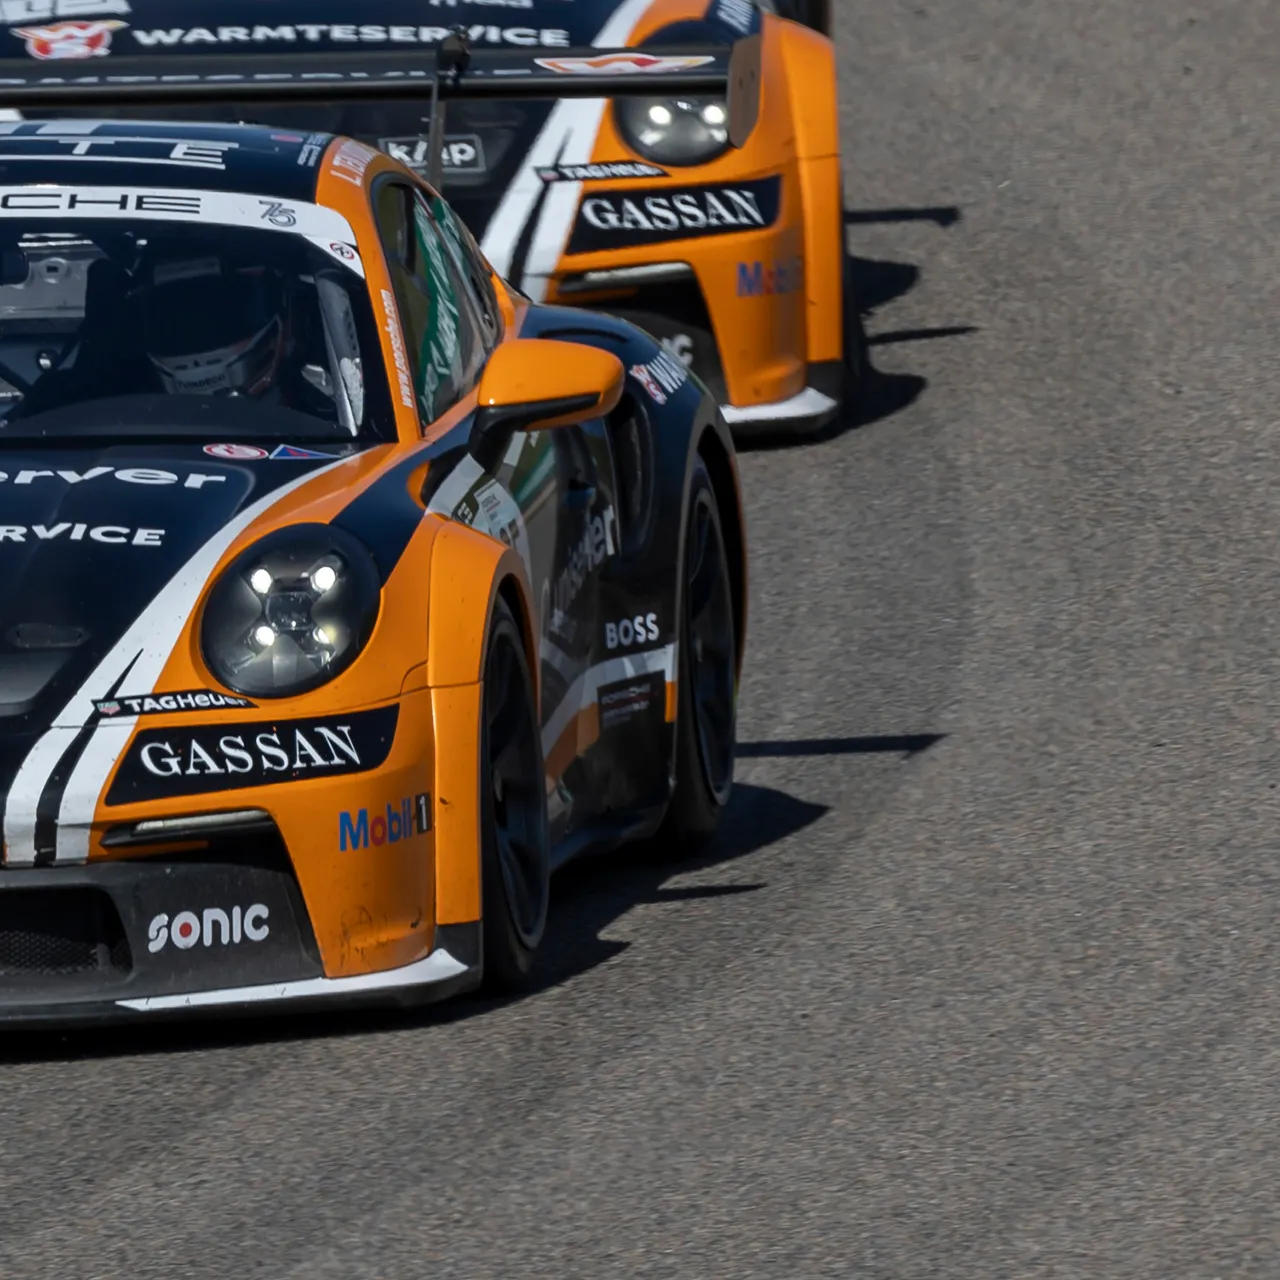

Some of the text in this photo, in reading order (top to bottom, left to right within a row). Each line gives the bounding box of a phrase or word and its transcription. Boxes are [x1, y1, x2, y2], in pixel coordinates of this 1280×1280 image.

[131, 21, 571, 49] WARMTESERVICE
[581, 188, 767, 231] GASSAN
[605, 612, 660, 649] BOSS
[139, 725, 362, 777] GASSAN
